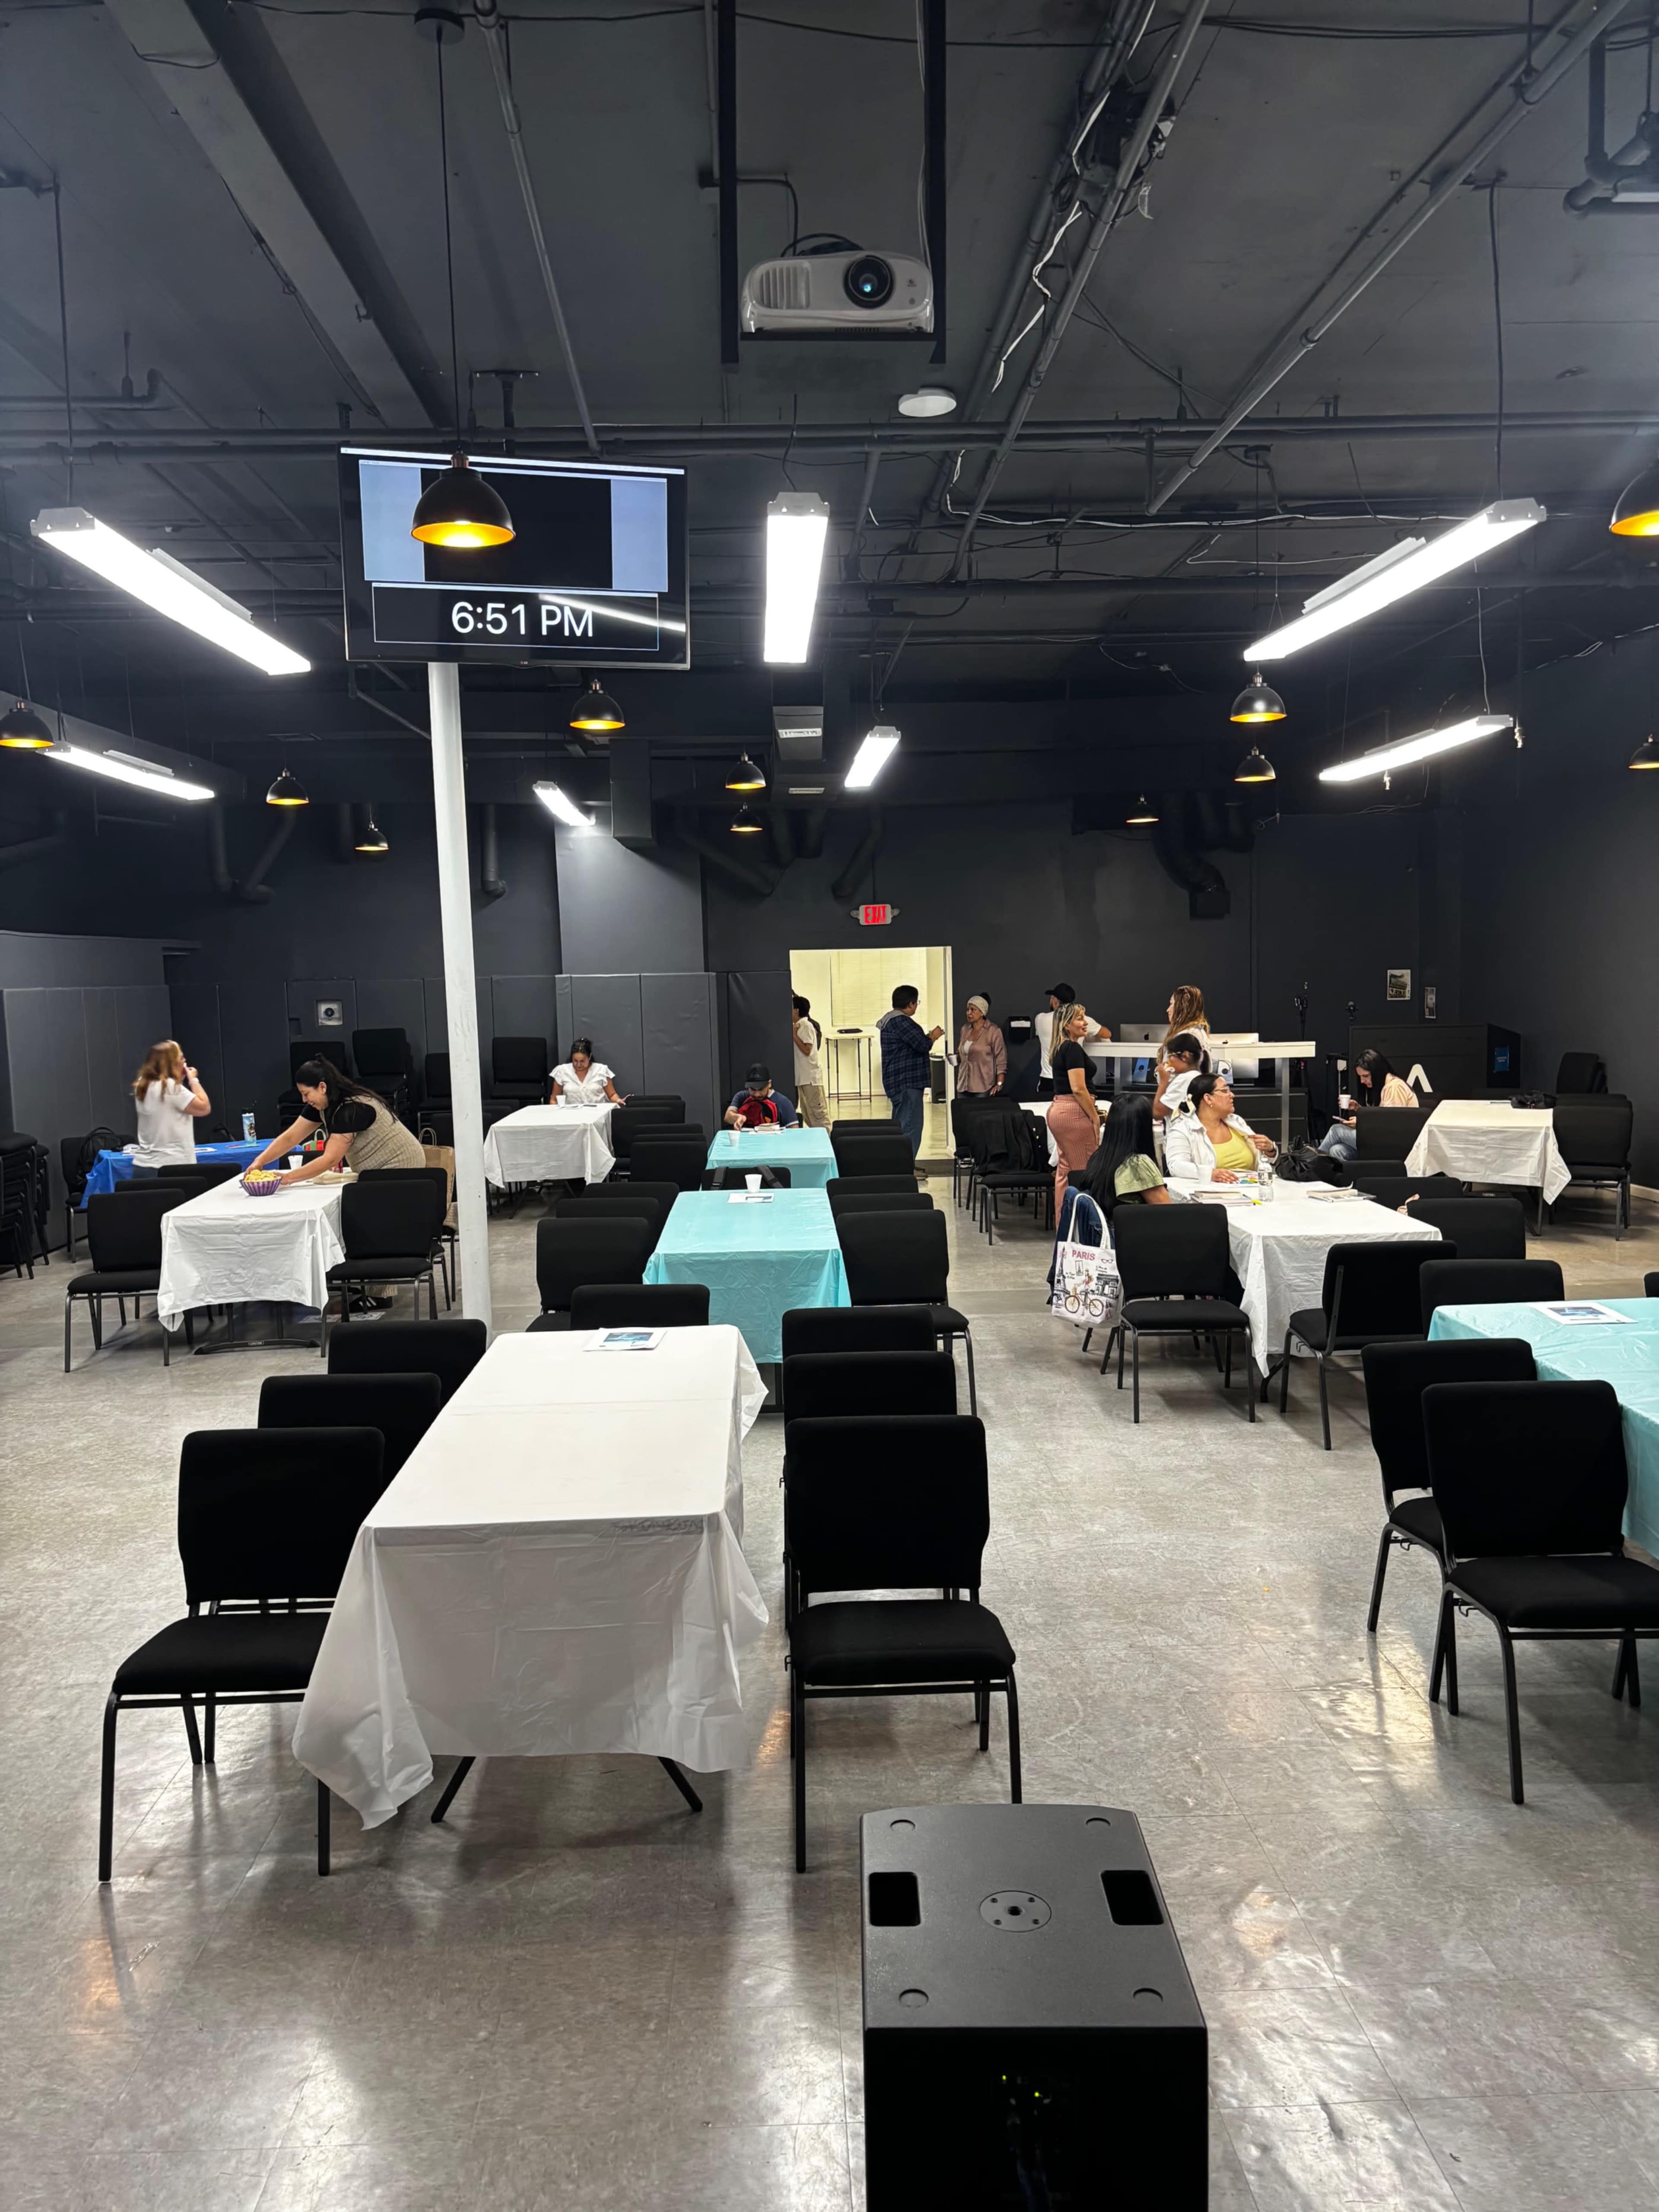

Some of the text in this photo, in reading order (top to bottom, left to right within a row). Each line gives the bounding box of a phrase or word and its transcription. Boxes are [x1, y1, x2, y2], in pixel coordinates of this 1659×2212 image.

[452, 602, 592, 637] 6:51 PM
[864, 905, 887, 924] EXIT
[1072, 1249, 1095, 1261] PARIS
